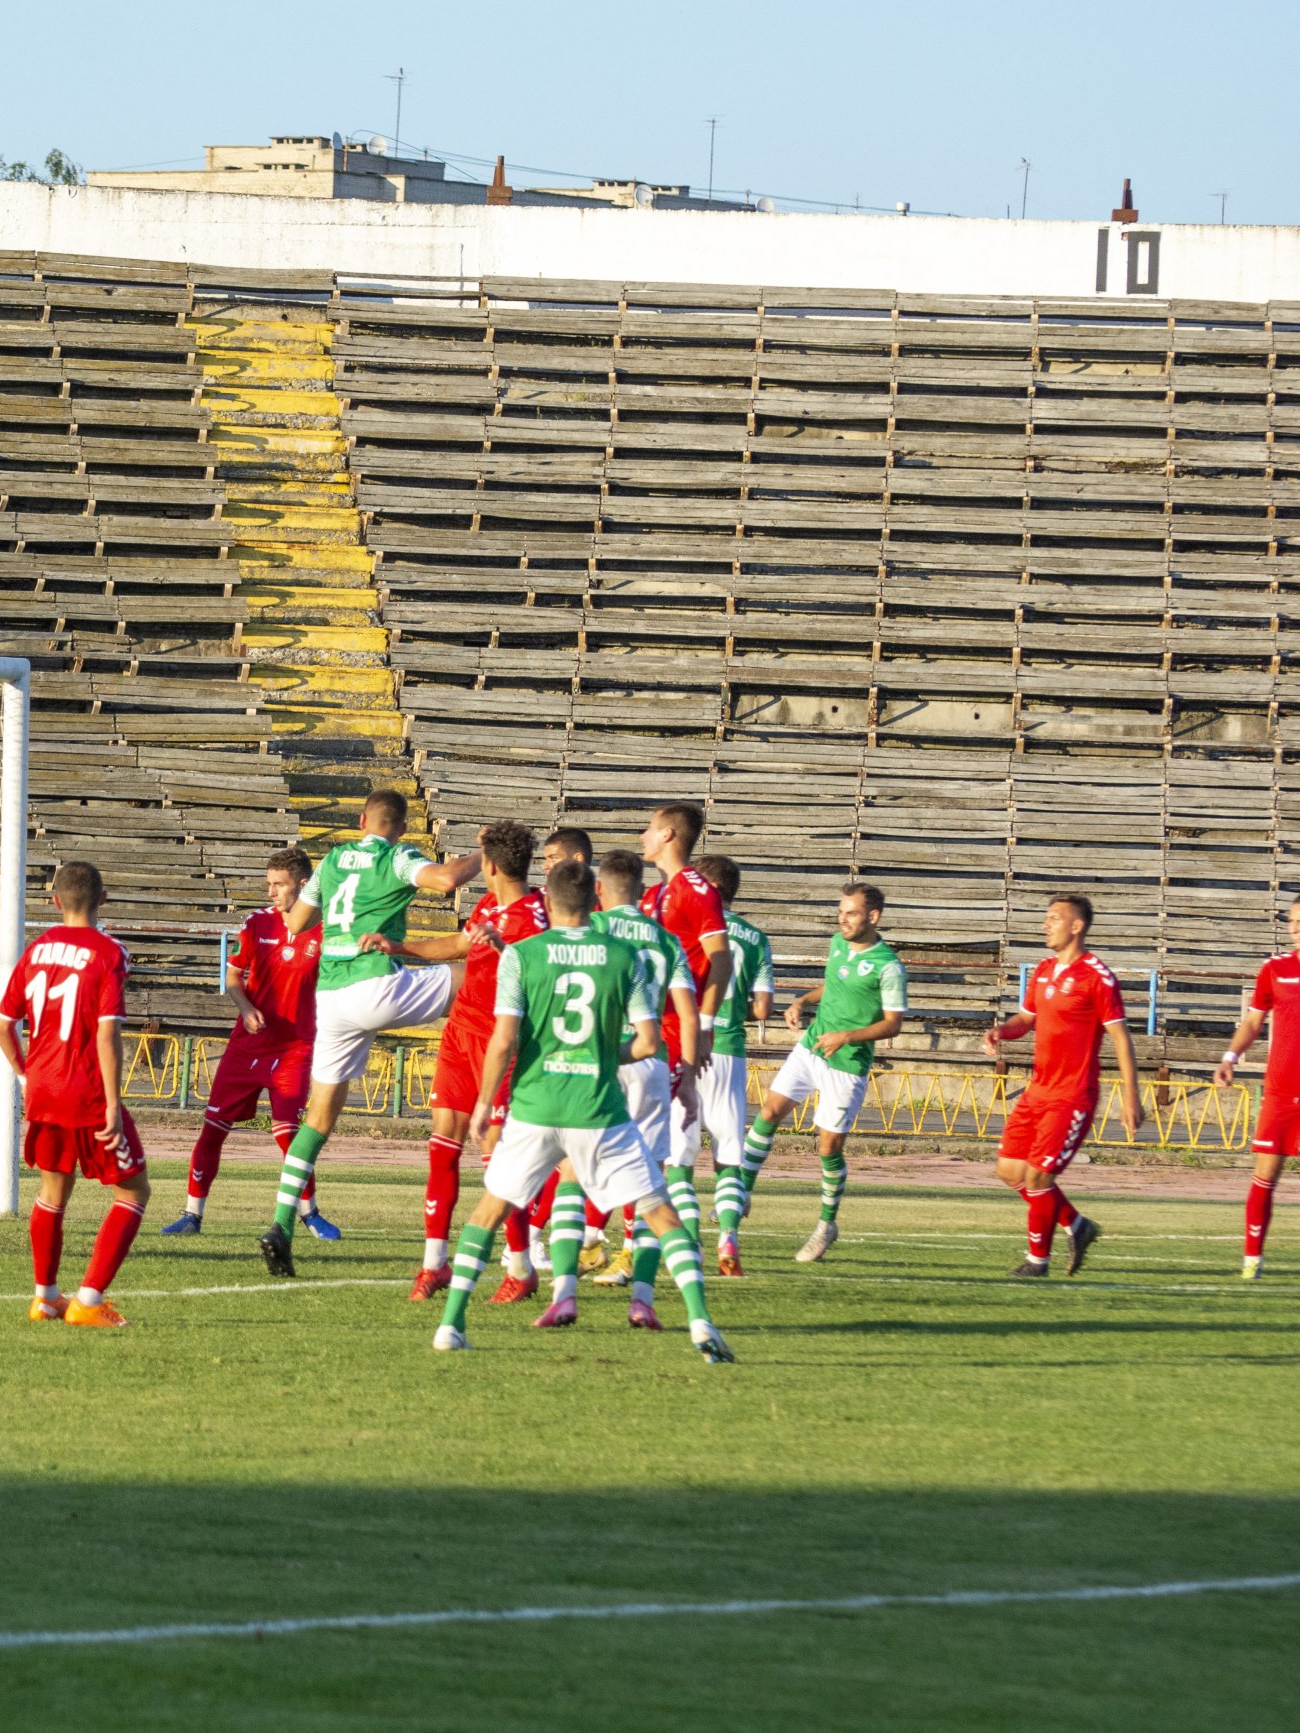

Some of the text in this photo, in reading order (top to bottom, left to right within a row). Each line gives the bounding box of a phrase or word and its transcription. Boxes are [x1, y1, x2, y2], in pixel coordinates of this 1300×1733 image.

[1096, 229, 1161, 295] 10
[327, 873, 360, 933] 4
[726, 921, 760, 945] ЛЬКО
[547, 943, 607, 965] ХОХЛОВ
[25, 970, 79, 1041] 11
[552, 971, 596, 1045] 3
[1042, 1155, 1054, 1168] 7
